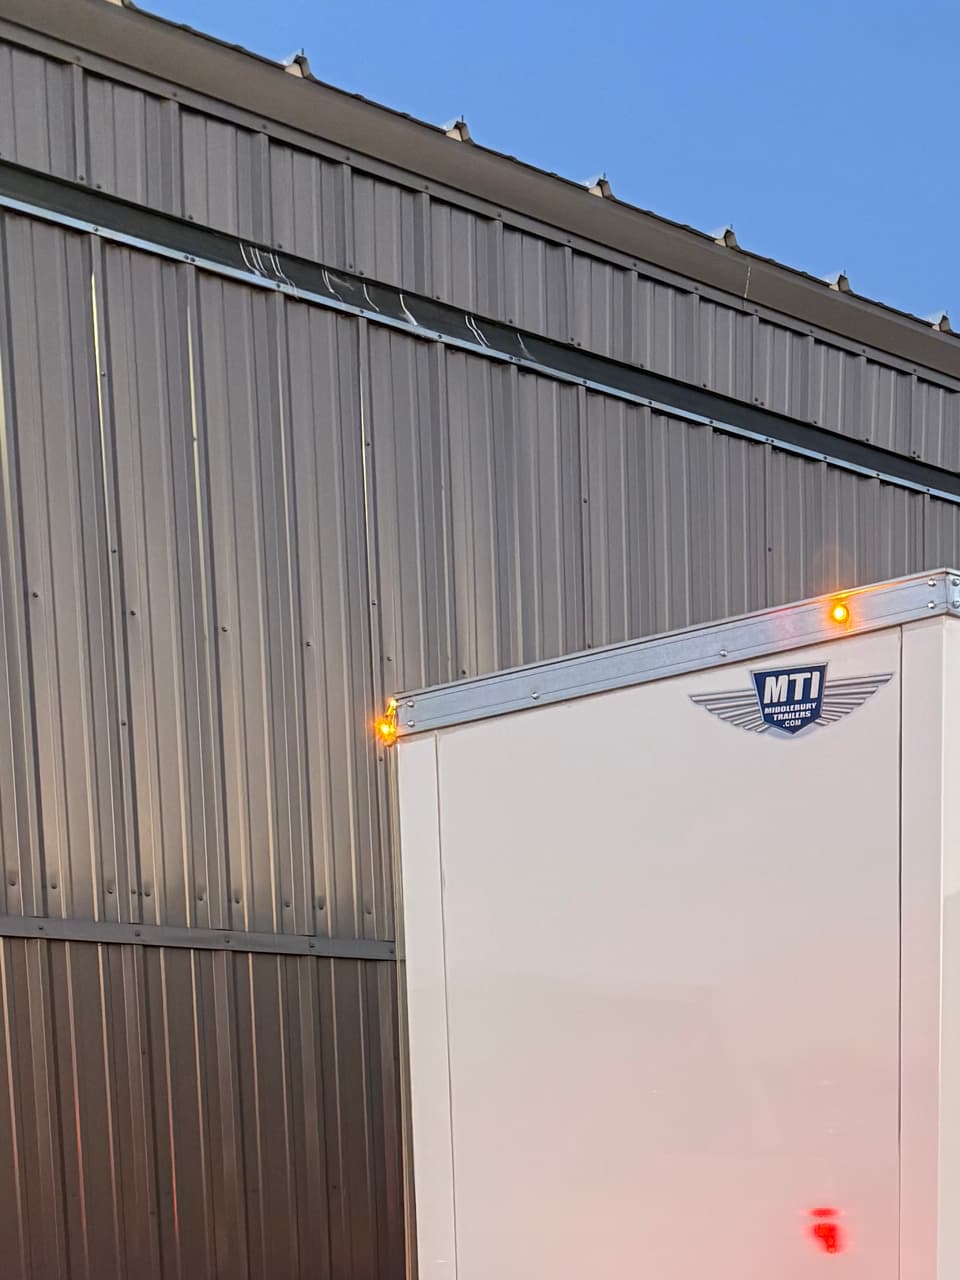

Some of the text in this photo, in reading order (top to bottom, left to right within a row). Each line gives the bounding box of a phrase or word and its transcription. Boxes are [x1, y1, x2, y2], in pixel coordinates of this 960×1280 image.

[763, 671, 820, 704] MTI
[764, 702, 817, 714] MIDDLEBURY
[773, 711, 811, 721] TRAILERS
